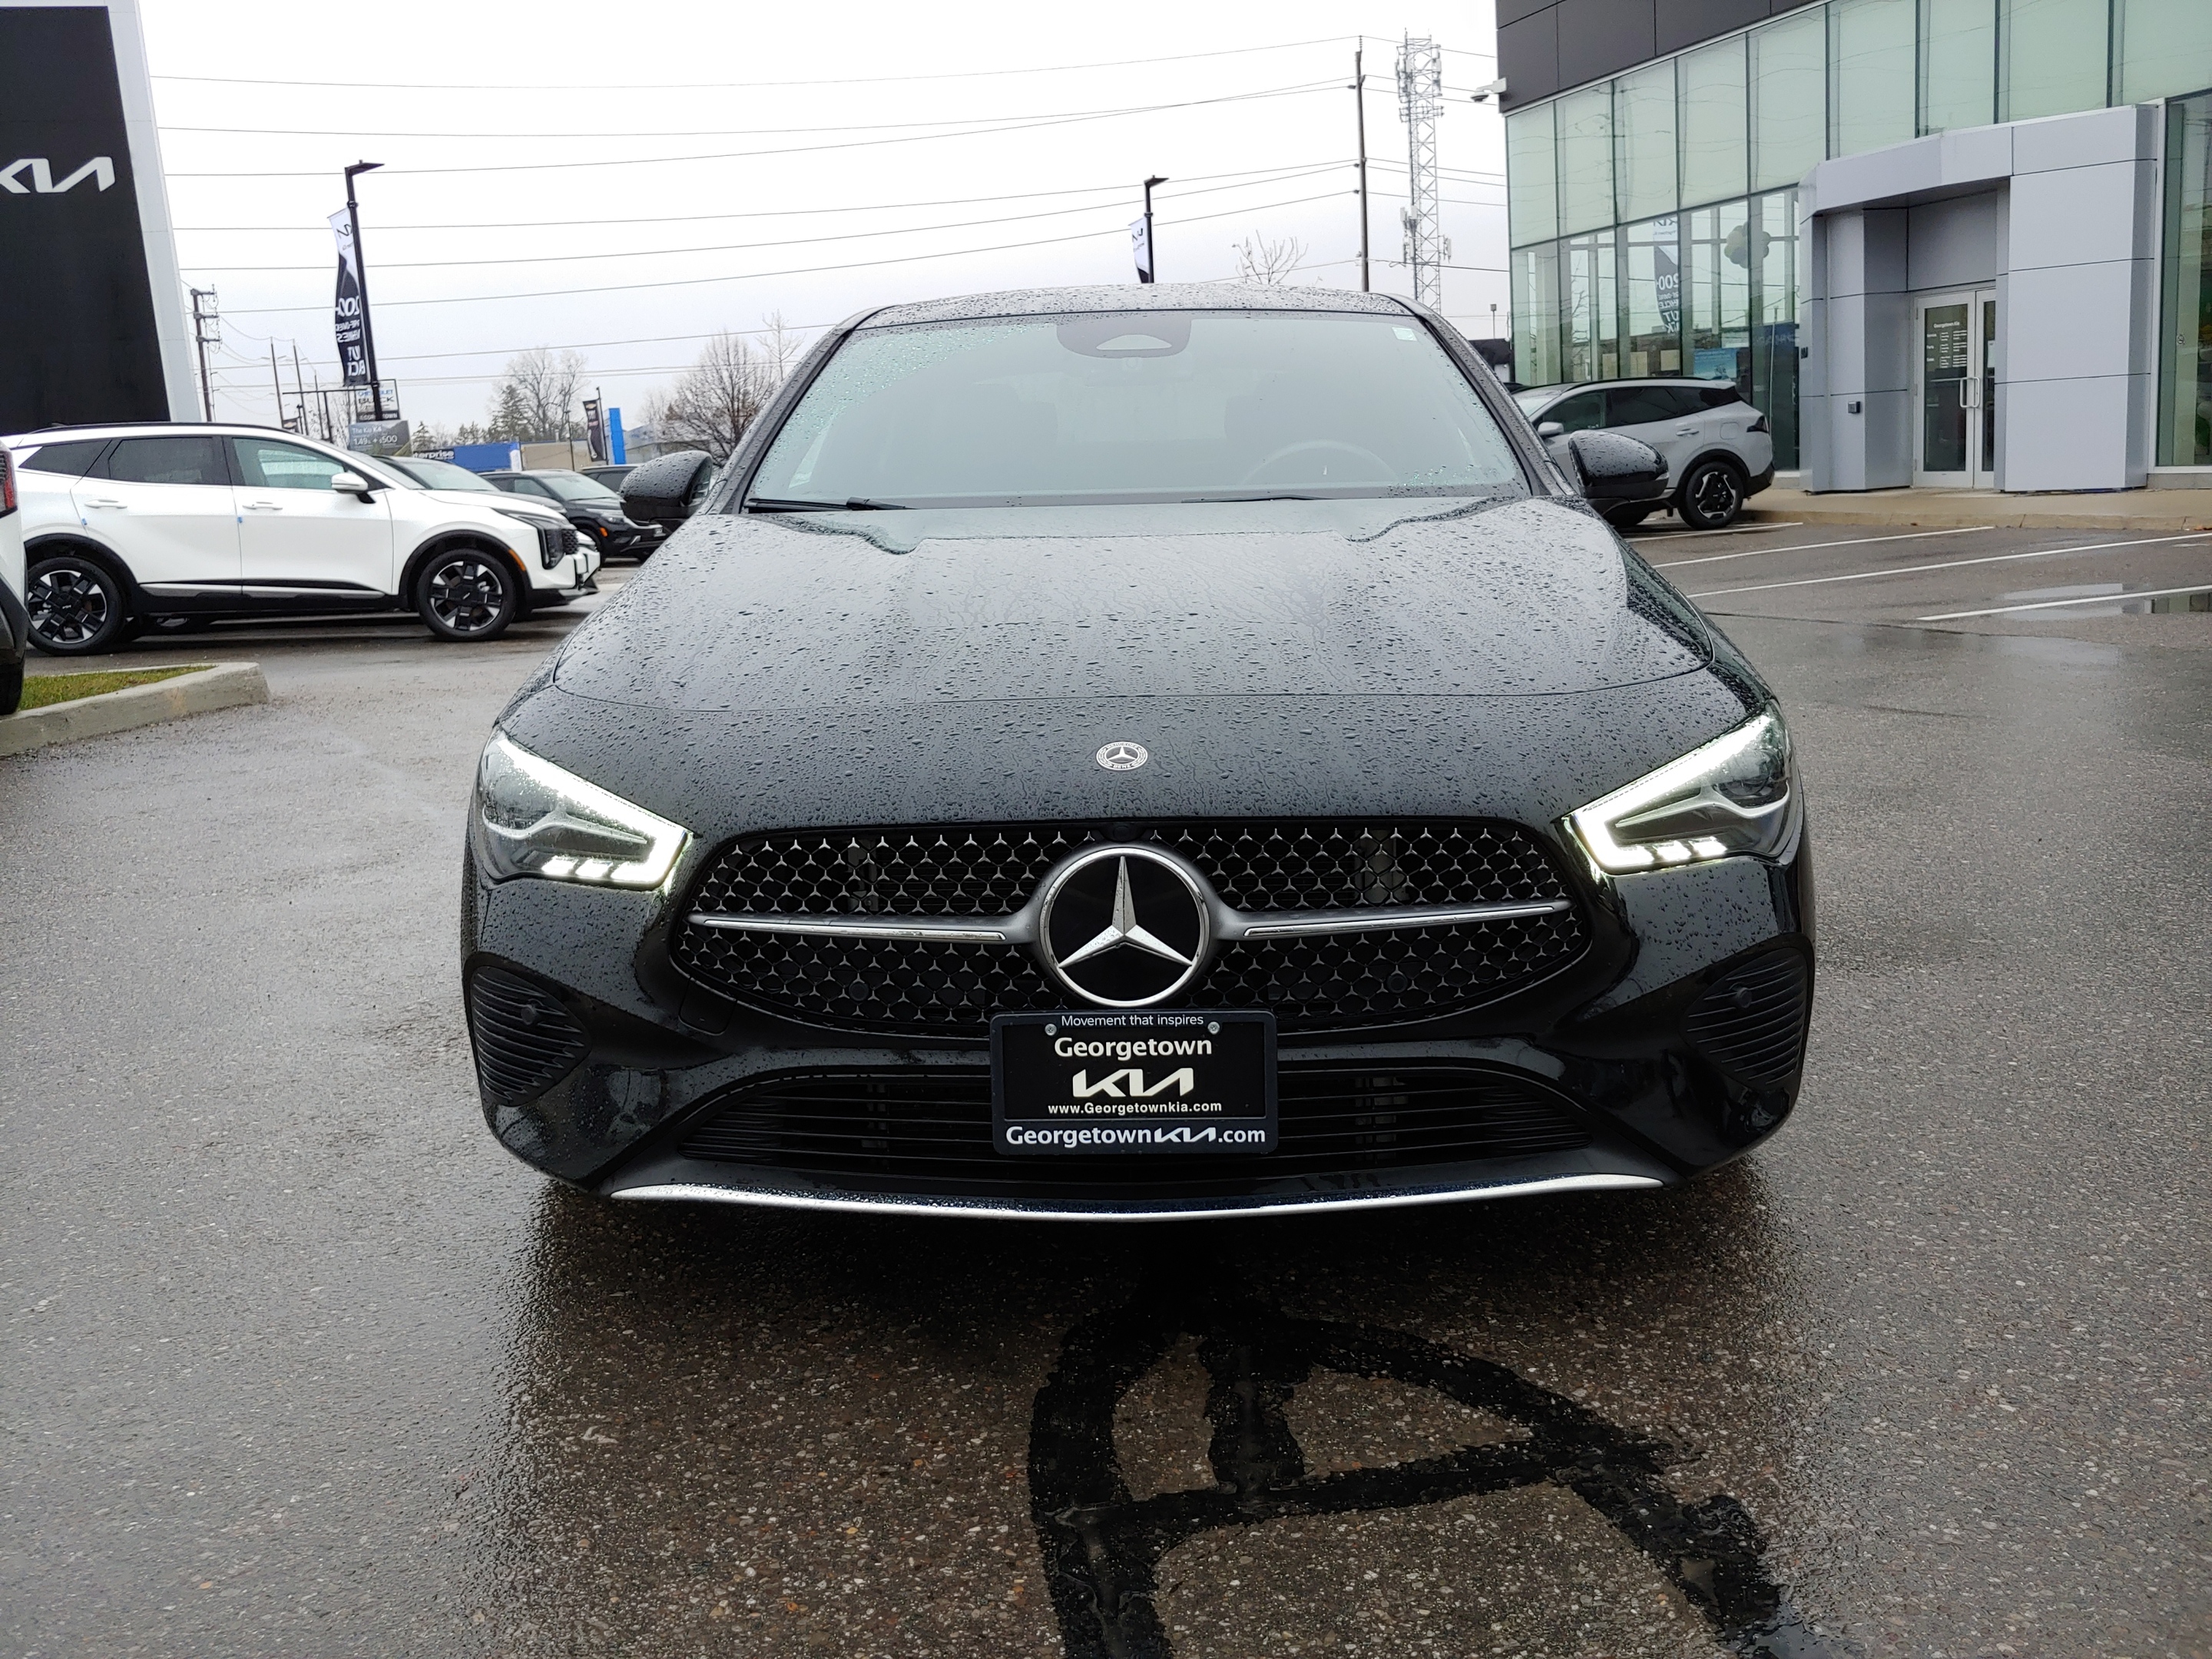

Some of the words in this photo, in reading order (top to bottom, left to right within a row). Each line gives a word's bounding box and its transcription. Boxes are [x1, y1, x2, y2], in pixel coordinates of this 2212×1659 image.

[1061, 1015, 1126, 1027] Movement
[1129, 1014, 1154, 1026] that
[1157, 1014, 1204, 1028] inspires
[1054, 1037, 1213, 1061] Georgetown
[1072, 1067, 1195, 1098] KIA
[1048, 1101, 1223, 1116] www.Georgetownkia.com
